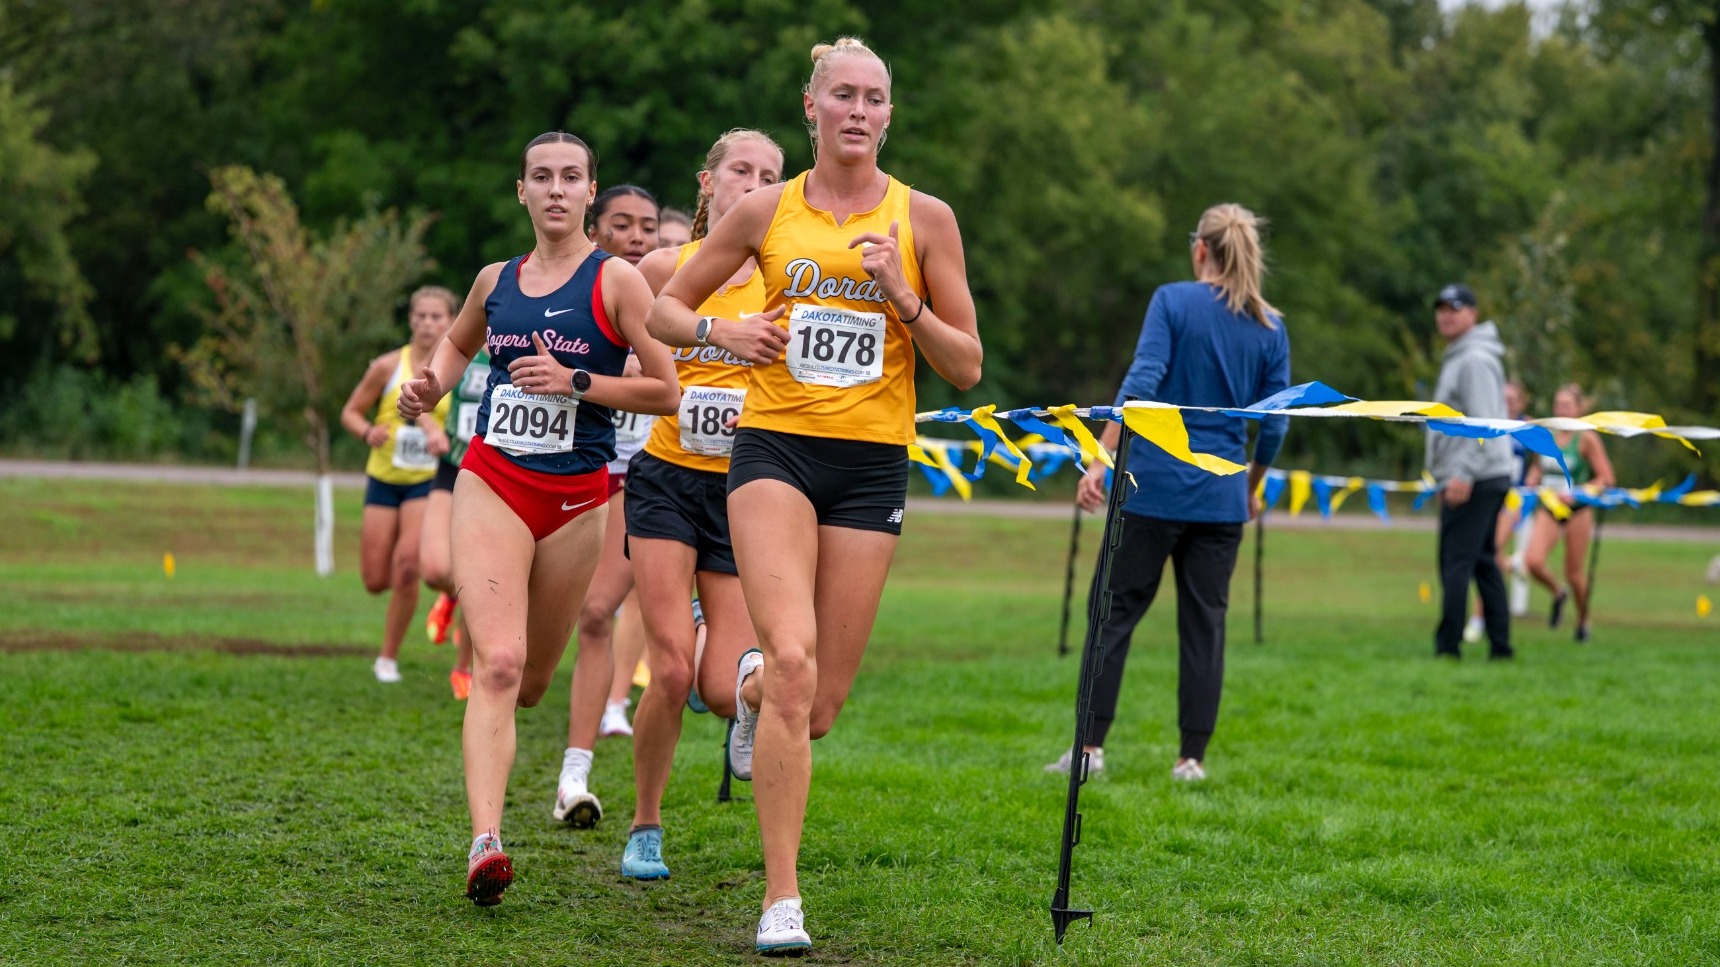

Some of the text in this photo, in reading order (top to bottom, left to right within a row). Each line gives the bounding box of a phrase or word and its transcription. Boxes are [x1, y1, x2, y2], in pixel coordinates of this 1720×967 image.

[801, 310, 876, 327] DAKOTATIMING
[543, 329, 590, 355] State
[798, 325, 876, 367] 1878
[493, 402, 568, 441] 2094
[687, 405, 739, 437] 189
